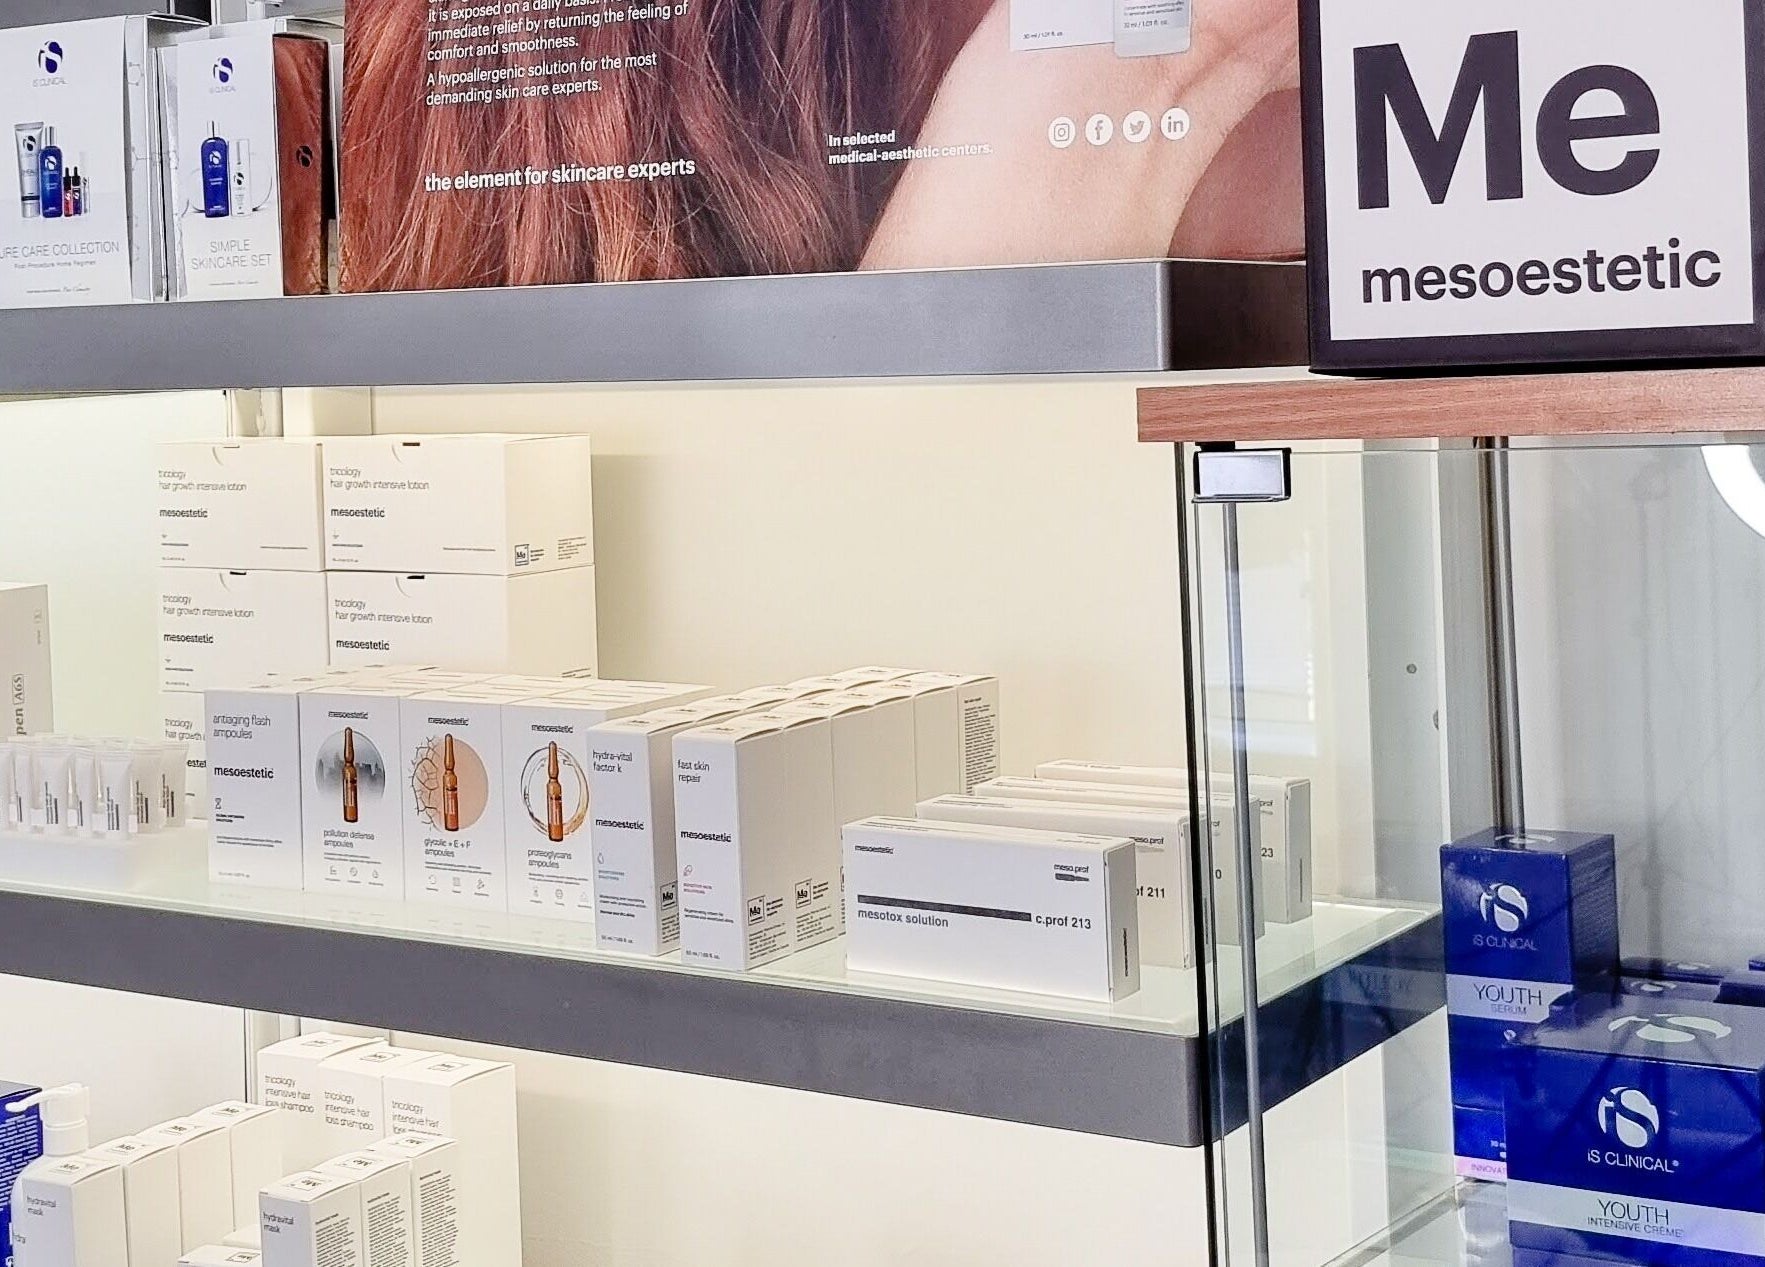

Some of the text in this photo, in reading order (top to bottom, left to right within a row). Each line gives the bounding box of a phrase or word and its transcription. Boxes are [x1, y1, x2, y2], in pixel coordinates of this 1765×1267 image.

[428, 9, 436, 22] it
[440, 8, 448, 20] is
[451, 1, 500, 21] exposed
[504, 3, 519, 14] on
[522, 2, 530, 11] a
[428, 1, 688, 41] immediate relief by returning the feeling of
[427, 36, 579, 61] comfort and smoothness.
[426, 52, 658, 86] A hypoallergenic solution for the most
[426, 79, 602, 106] demanding skin care experts.
[1353, 30, 1660, 209] Me
[828, 130, 896, 148] In selected
[828, 143, 993, 165] medical-aesthetic centers.
[425, 158, 696, 192] the element for skincare experts
[22, 245, 49, 258] CARE
[52, 241, 120, 256] COLLECTION
[210, 238, 251, 253] SIMPLE
[191, 253, 272, 270] SKINCARE SET
[1362, 237, 1722, 303] mesoestetic
[159, 507, 208, 518] mesoestetic
[330, 507, 386, 518] mesoestetic
[164, 633, 214, 643] mesoestetic
[336, 640, 390, 651] mesoestetic
[213, 715, 271, 727] antiaging flash
[328, 711, 369, 719] mesoestetic
[428, 717, 470, 726] mesoestetic
[213, 728, 253, 739] ampoules
[531, 724, 573, 733] mesoestetic
[593, 750, 632, 762] hydra-vital
[593, 762, 622, 773] factor k
[677, 759, 710, 772] fast skin
[214, 766, 274, 779] mesoestetic
[678, 772, 701, 784] repair
[595, 819, 645, 831] mesoestetic
[680, 830, 732, 843] mesoestetic
[855, 845, 894, 855] mesoestetic
[1261, 847, 1274, 858] 23
[1147, 887, 1165, 898] 211
[858, 909, 949, 928] mesotox solution
[1035, 914, 1092, 930] c.prof 213
[1486, 935, 1538, 951] CLINICAL
[1473, 983, 1542, 1006] YOUTH
[1491, 1003, 1527, 1015] SERUM
[1598, 1199, 1670, 1226] YOUTH
[1588, 1216, 1641, 1233] INTENSIVE
